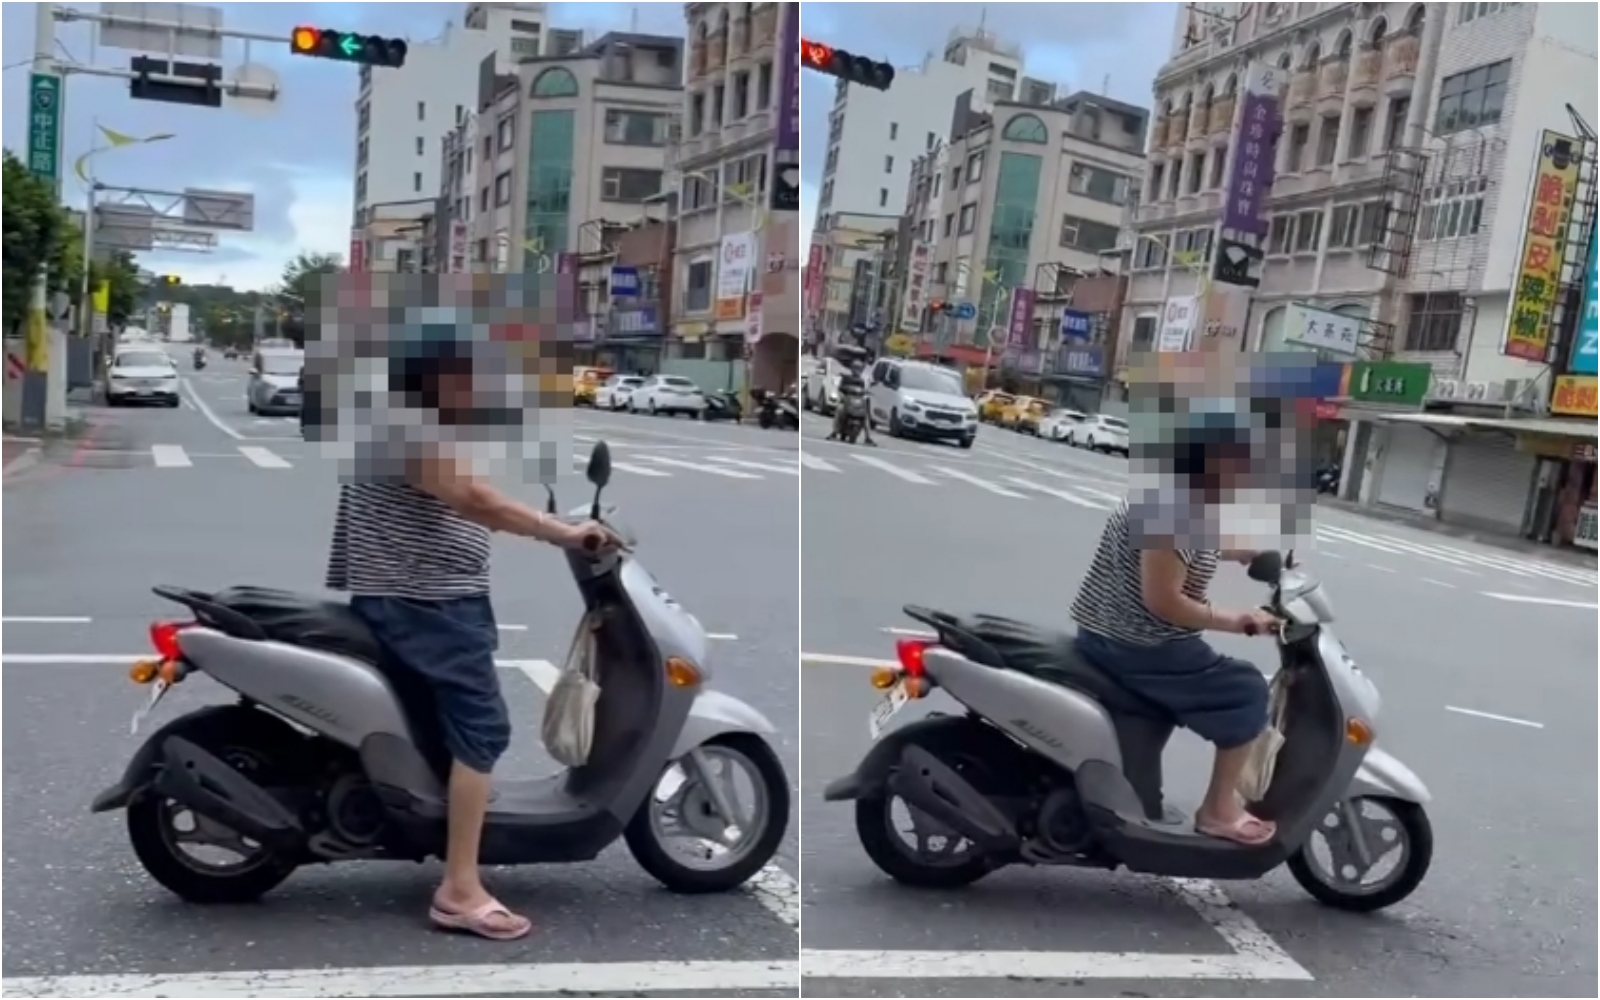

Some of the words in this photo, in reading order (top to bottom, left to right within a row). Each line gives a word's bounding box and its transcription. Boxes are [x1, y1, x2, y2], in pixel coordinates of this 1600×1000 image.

[33, 112, 53, 172] 中正路
[1306, 319, 1353, 343] 大茶苑
